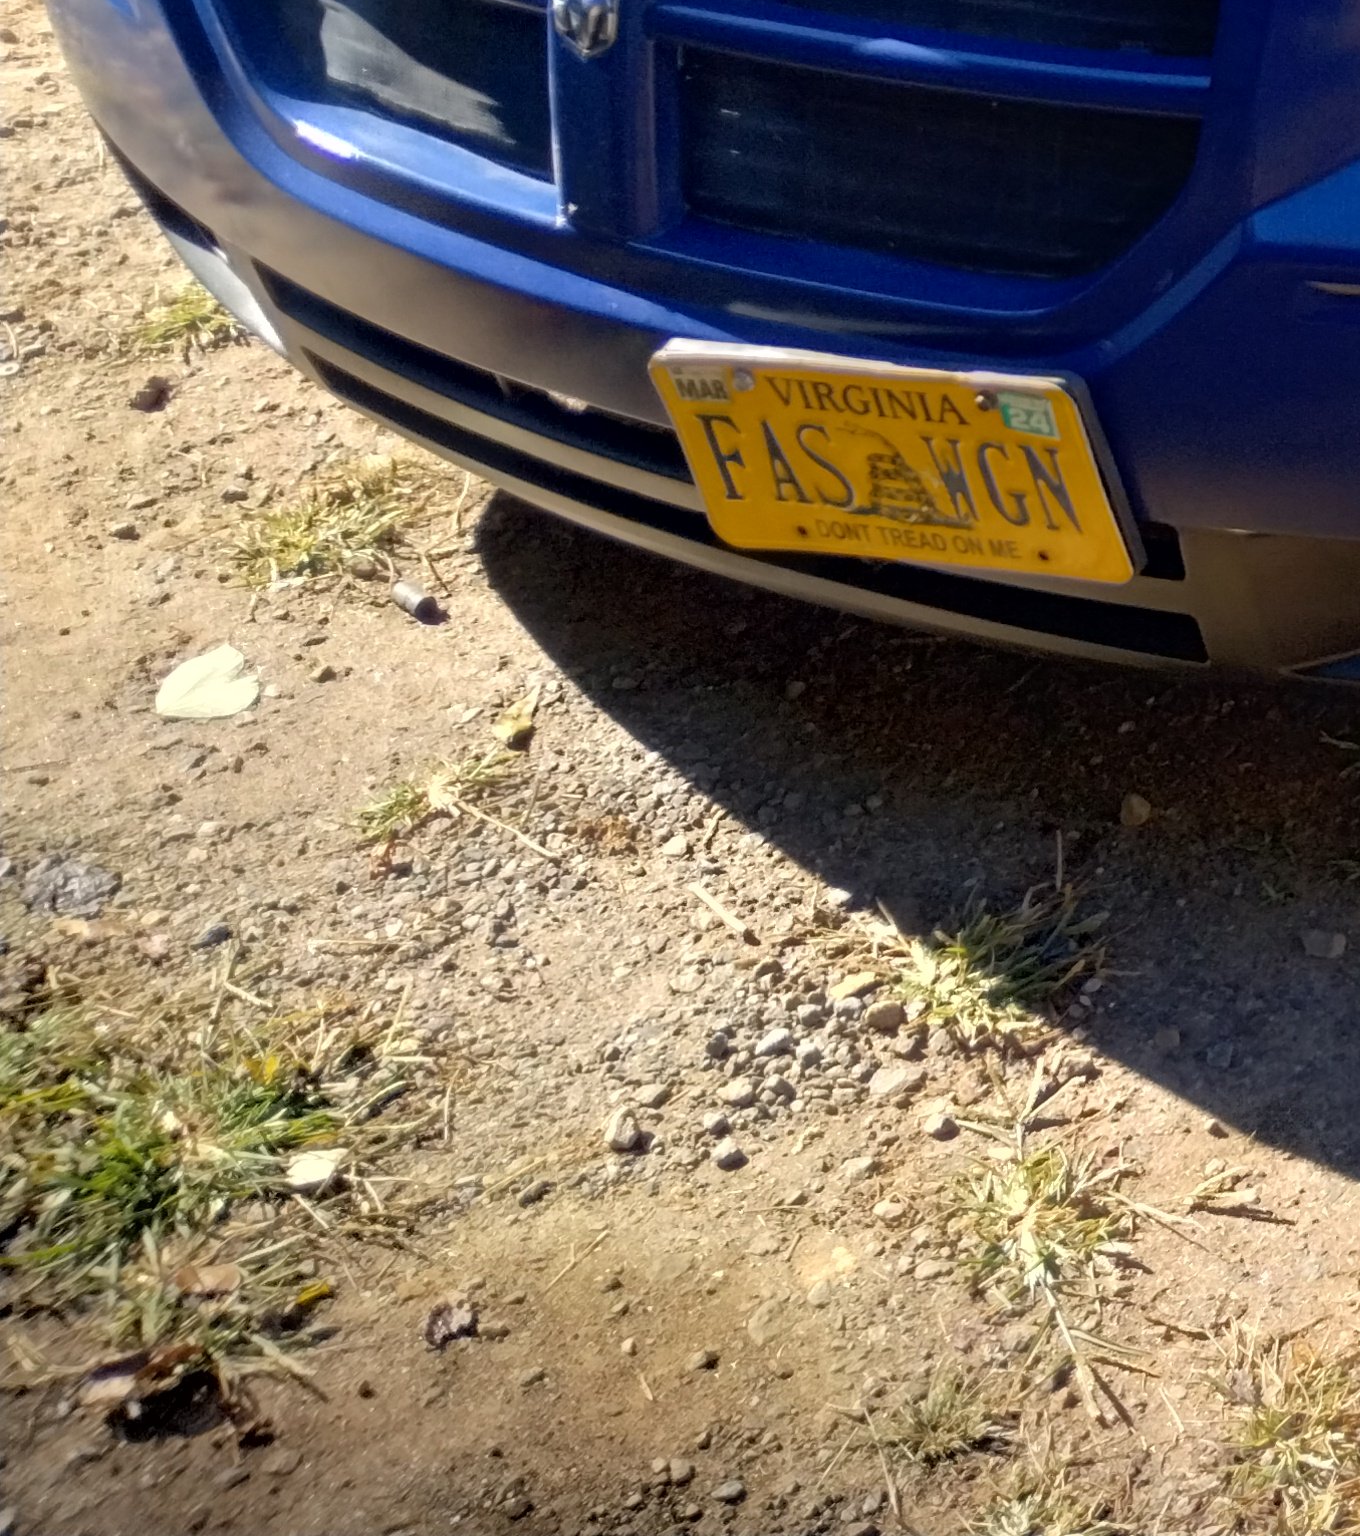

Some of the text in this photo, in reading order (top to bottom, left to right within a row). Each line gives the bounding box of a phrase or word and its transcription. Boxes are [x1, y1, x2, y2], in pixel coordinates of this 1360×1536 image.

[675, 377, 729, 402] MAR
[763, 374, 971, 427] VIRGINIA
[1010, 407, 1051, 434] 24
[694, 412, 1083, 535] FAS WGN
[814, 517, 1023, 560] DONT TREAD ON ME
